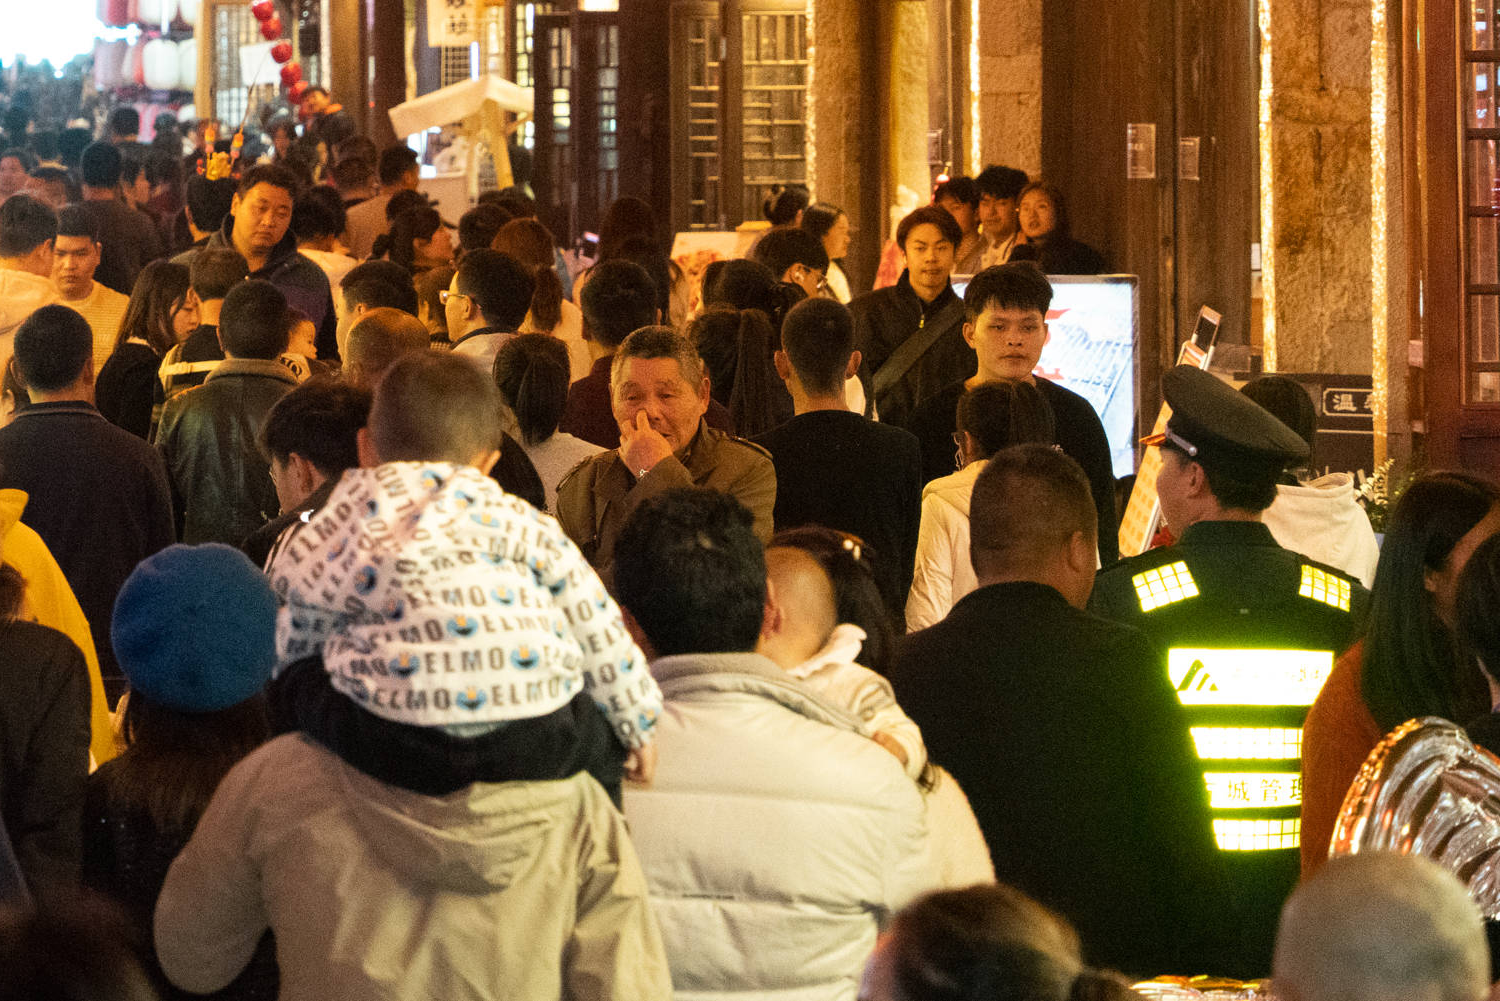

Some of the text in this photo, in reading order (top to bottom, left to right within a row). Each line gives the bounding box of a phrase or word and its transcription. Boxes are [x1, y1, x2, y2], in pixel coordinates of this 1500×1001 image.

[423, 647, 504, 674] ELMO
[491, 676, 562, 707] ELMO
[1205, 778, 1301, 802] 城管理
